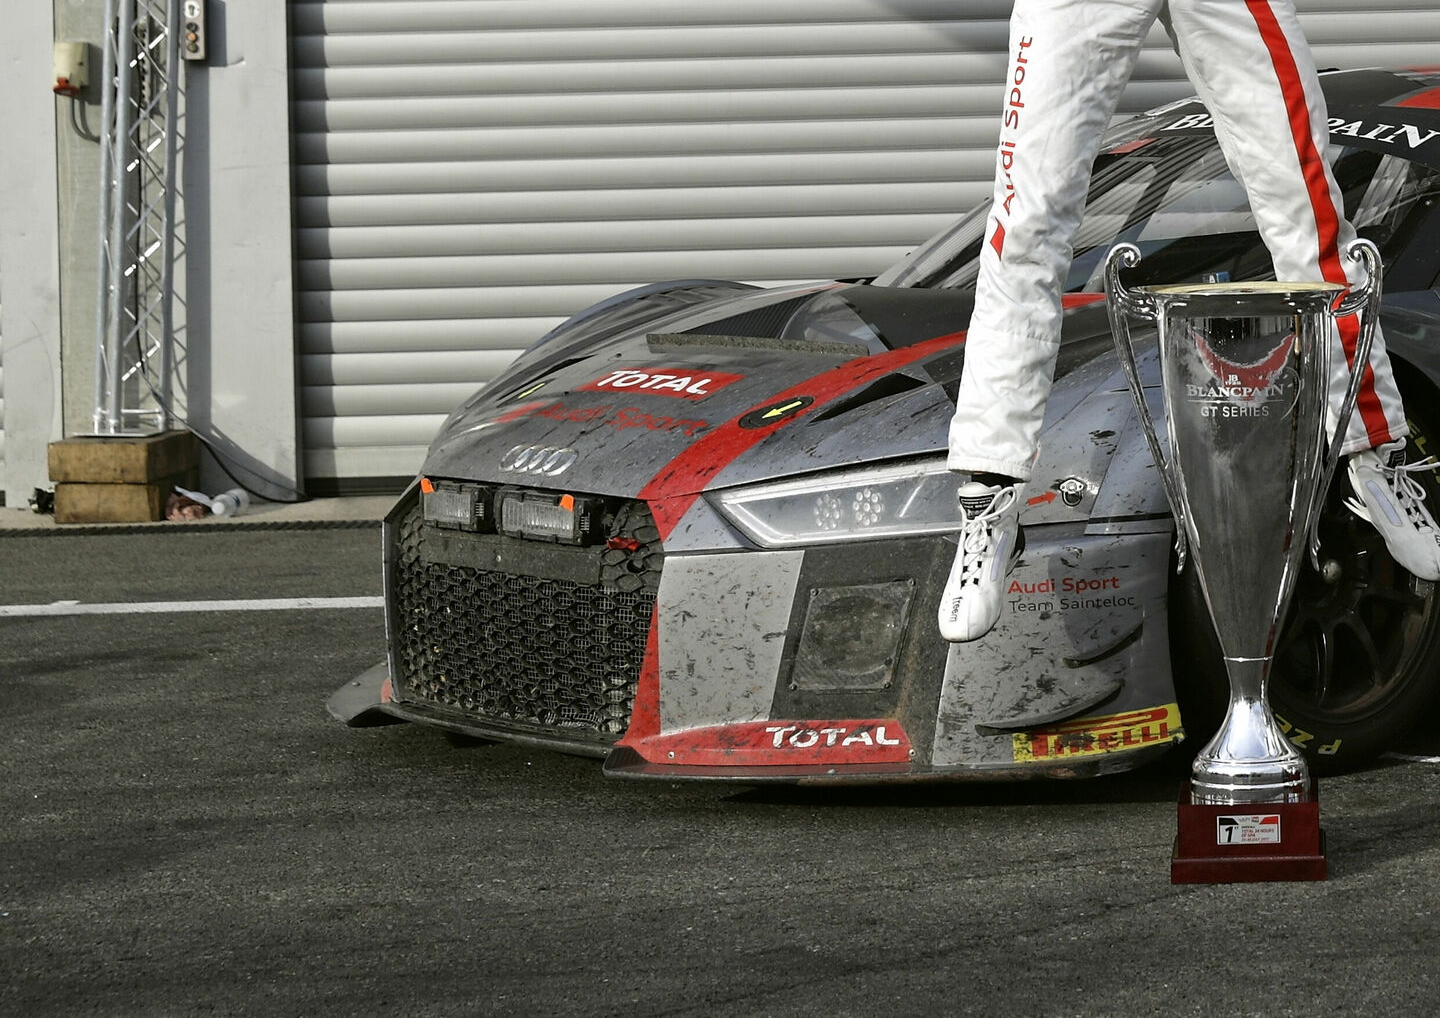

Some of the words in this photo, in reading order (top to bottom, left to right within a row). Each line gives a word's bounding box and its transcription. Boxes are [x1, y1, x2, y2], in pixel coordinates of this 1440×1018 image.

[1005, 36, 1033, 129] Sport
[597, 371, 711, 394] TOTAL
[1186, 383, 1284, 397] BLANCPAIN
[532, 402, 611, 423] Audi
[605, 407, 708, 437] Sport
[1201, 406, 1217, 417] GT
[1222, 406, 1269, 417] SERIES
[1008, 579, 1055, 594] Audi
[1062, 576, 1120, 594] Sport
[949, 595, 962, 623] freem
[1008, 599, 1054, 612] Team
[765, 726, 900, 749] TOTAL
[1318, 739, 1342, 755] P
